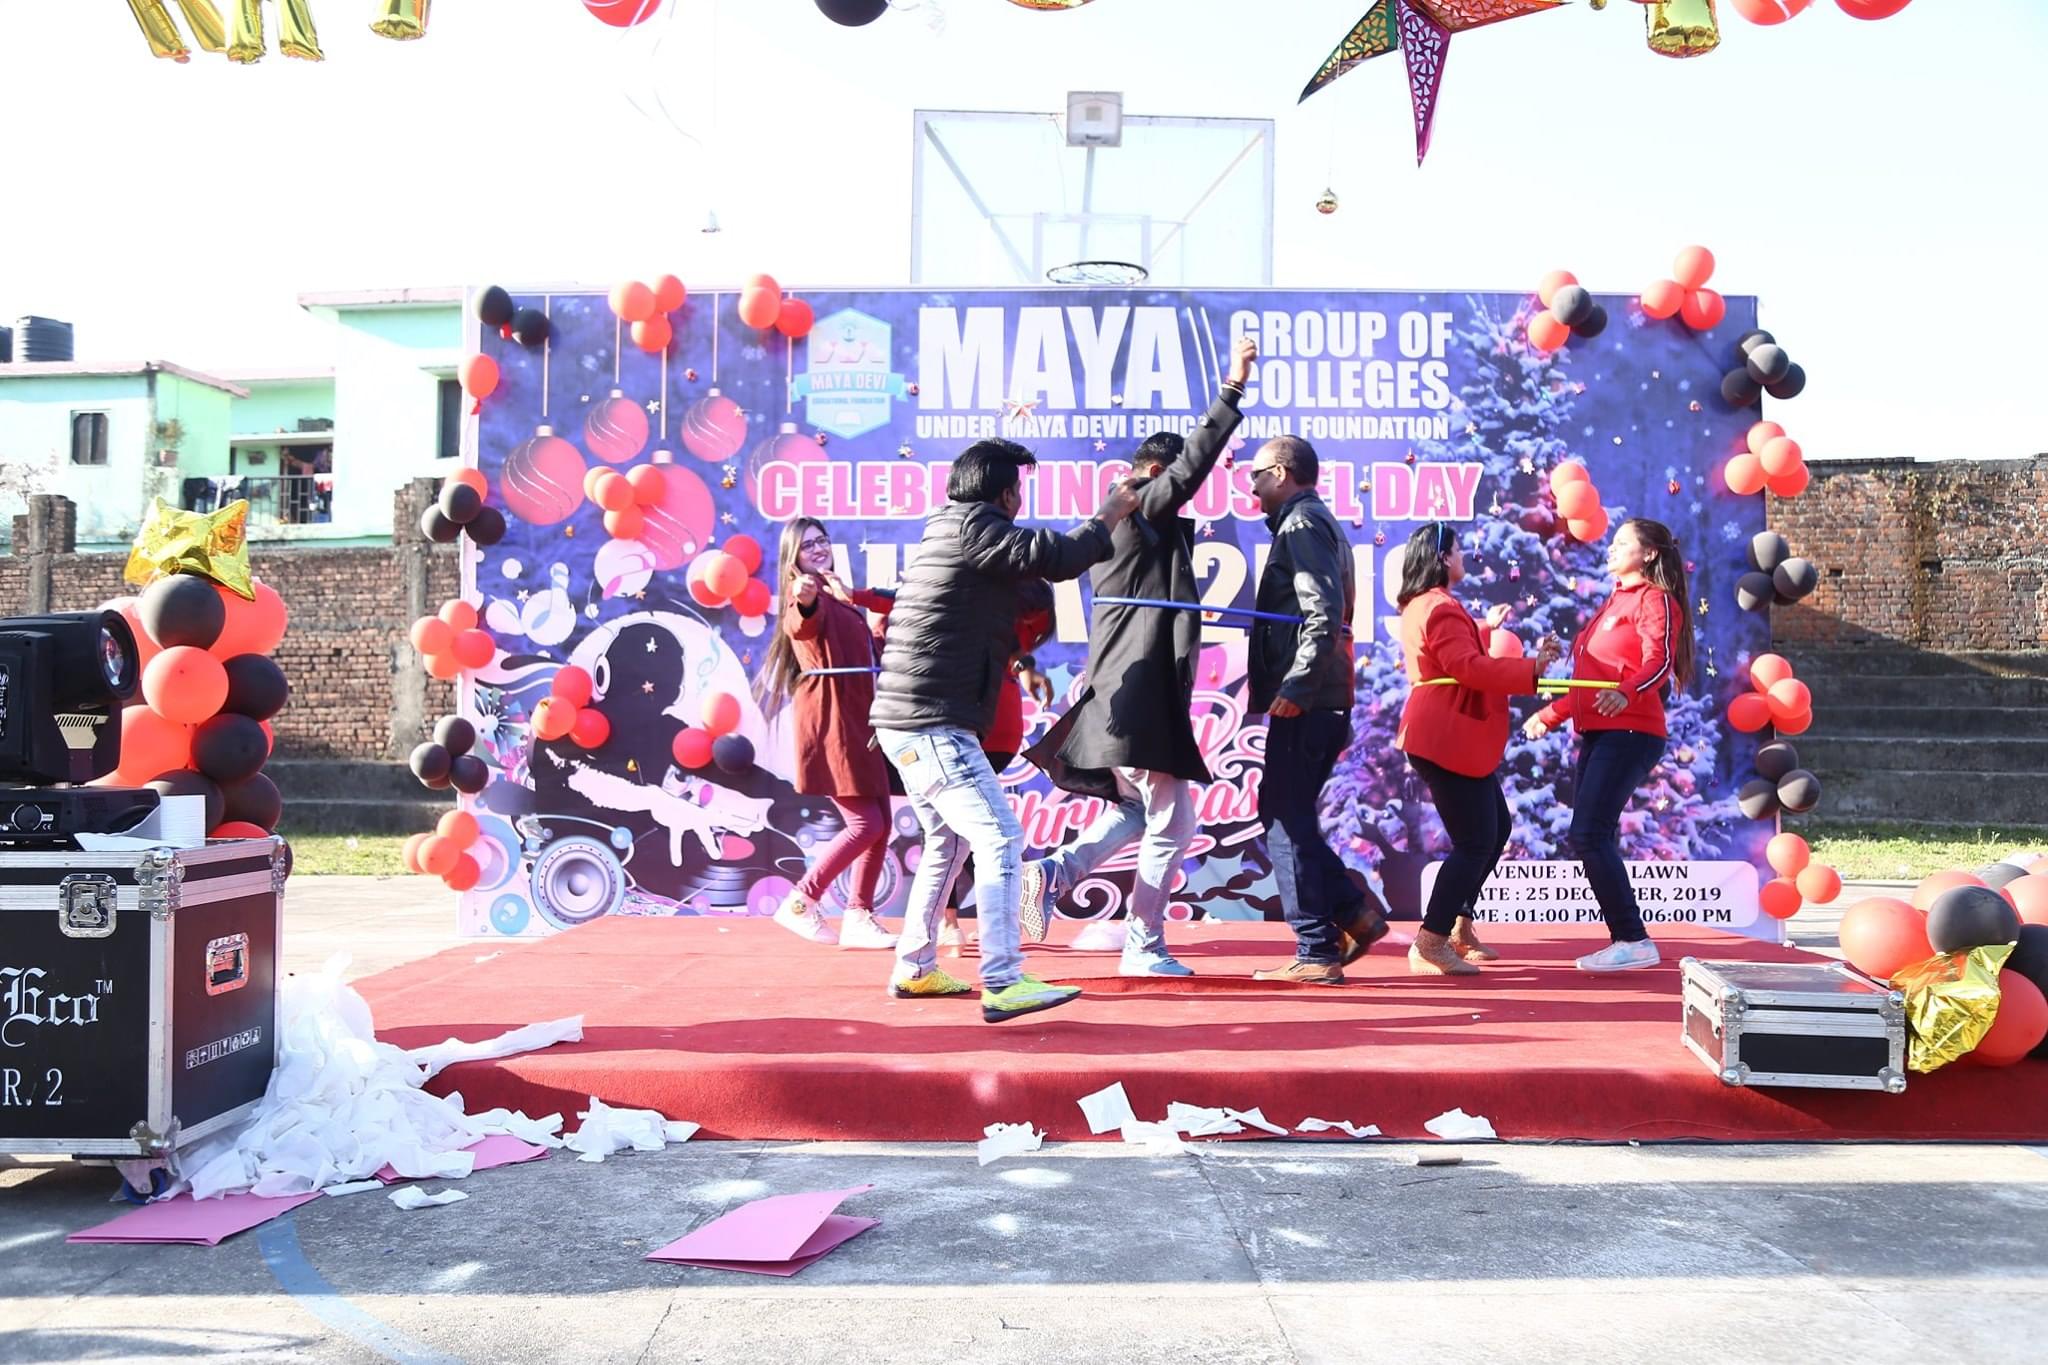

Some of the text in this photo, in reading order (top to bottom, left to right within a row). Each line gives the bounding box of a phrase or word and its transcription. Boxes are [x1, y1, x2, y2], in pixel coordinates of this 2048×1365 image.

[1230, 310, 1453, 358] GROUP OF
[919, 306, 1191, 409] MAYA
[810, 372, 887, 390] MAYA DEVI
[916, 415, 996, 438] UNDER
[1003, 415, 1068, 438] MAYA
[1073, 415, 1127, 438] DEVI
[1304, 416, 1449, 439] FOUNDATION
[1371, 461, 1484, 520] DAY
[1492, 865, 1556, 879] VENUE
[1632, 865, 1688, 879] LAWN
[1526, 887, 1549, 901] 25
[1673, 887, 1721, 901] 2019
[1515, 908, 1569, 922] 01:00
[1575, 909, 1604, 922] PM
[1642, 908, 1697, 922] 06:00
[1703, 909, 1732, 922] PM
